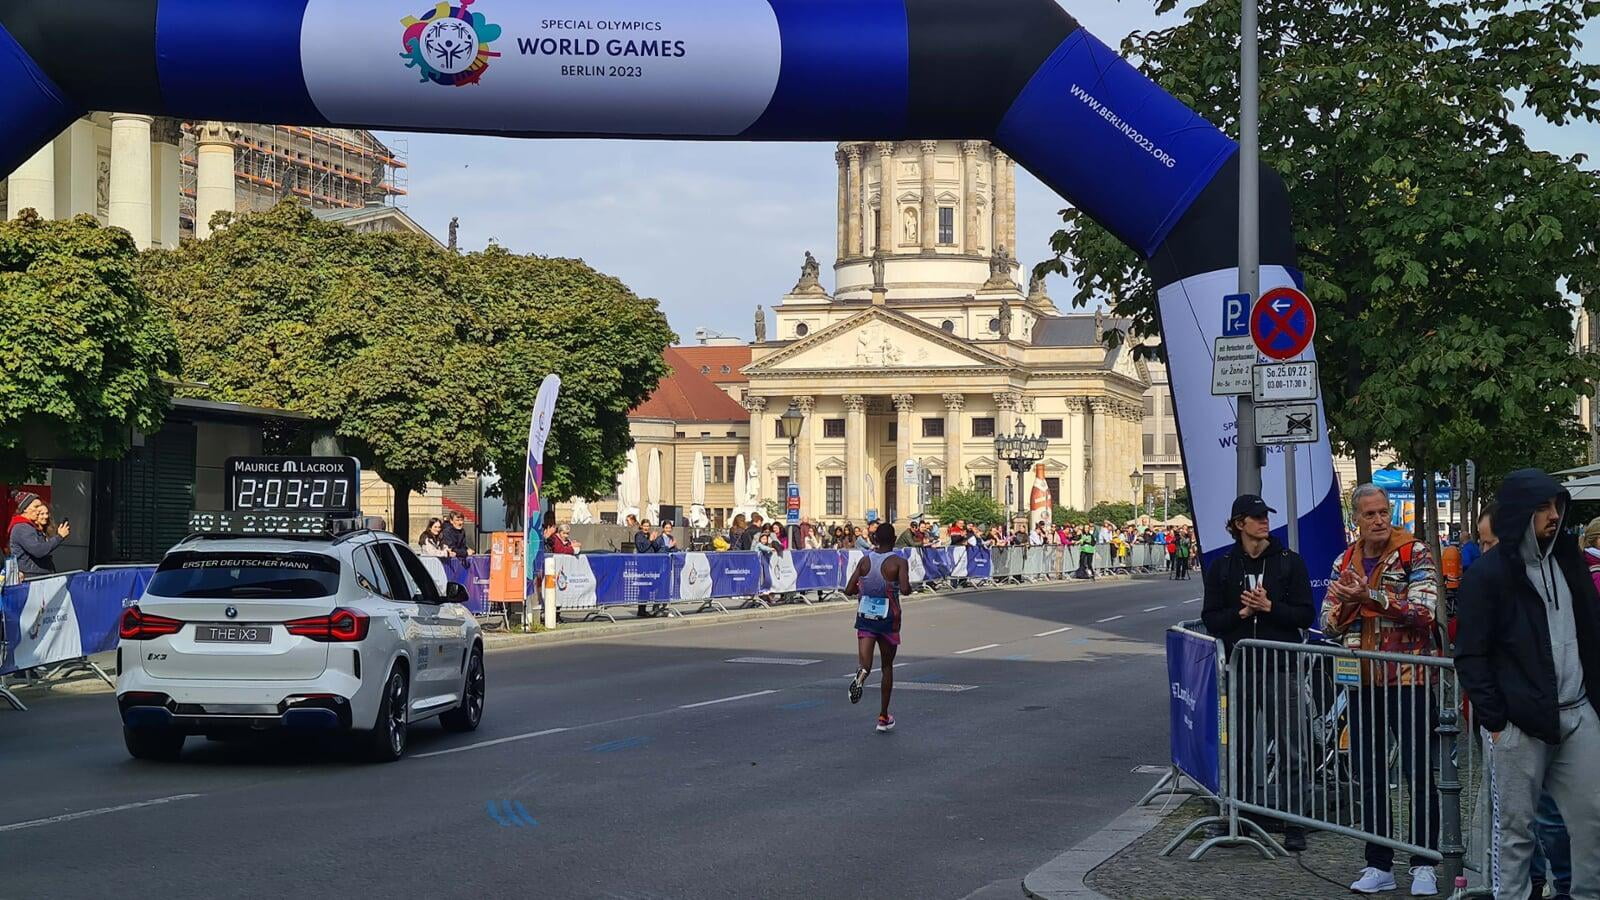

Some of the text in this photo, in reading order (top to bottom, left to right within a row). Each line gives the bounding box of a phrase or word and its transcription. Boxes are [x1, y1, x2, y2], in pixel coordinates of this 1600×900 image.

[541, 19, 662, 31] SPECIAL OLYMPICS
[517, 37, 686, 58] WORLD GAMES
[561, 65, 643, 78] BERLIN 2023
[1070, 84, 1177, 168] WWW.BERLIN2023.ORG
[1226, 300, 1242, 331] P
[235, 461, 280, 472] MAURICE
[300, 461, 345, 472] LACROIX
[238, 479, 348, 507] 2:03:27
[182, 559, 309, 570] ERSTER DEUTSCHER MANN
[210, 628, 258, 641] THE iX3
